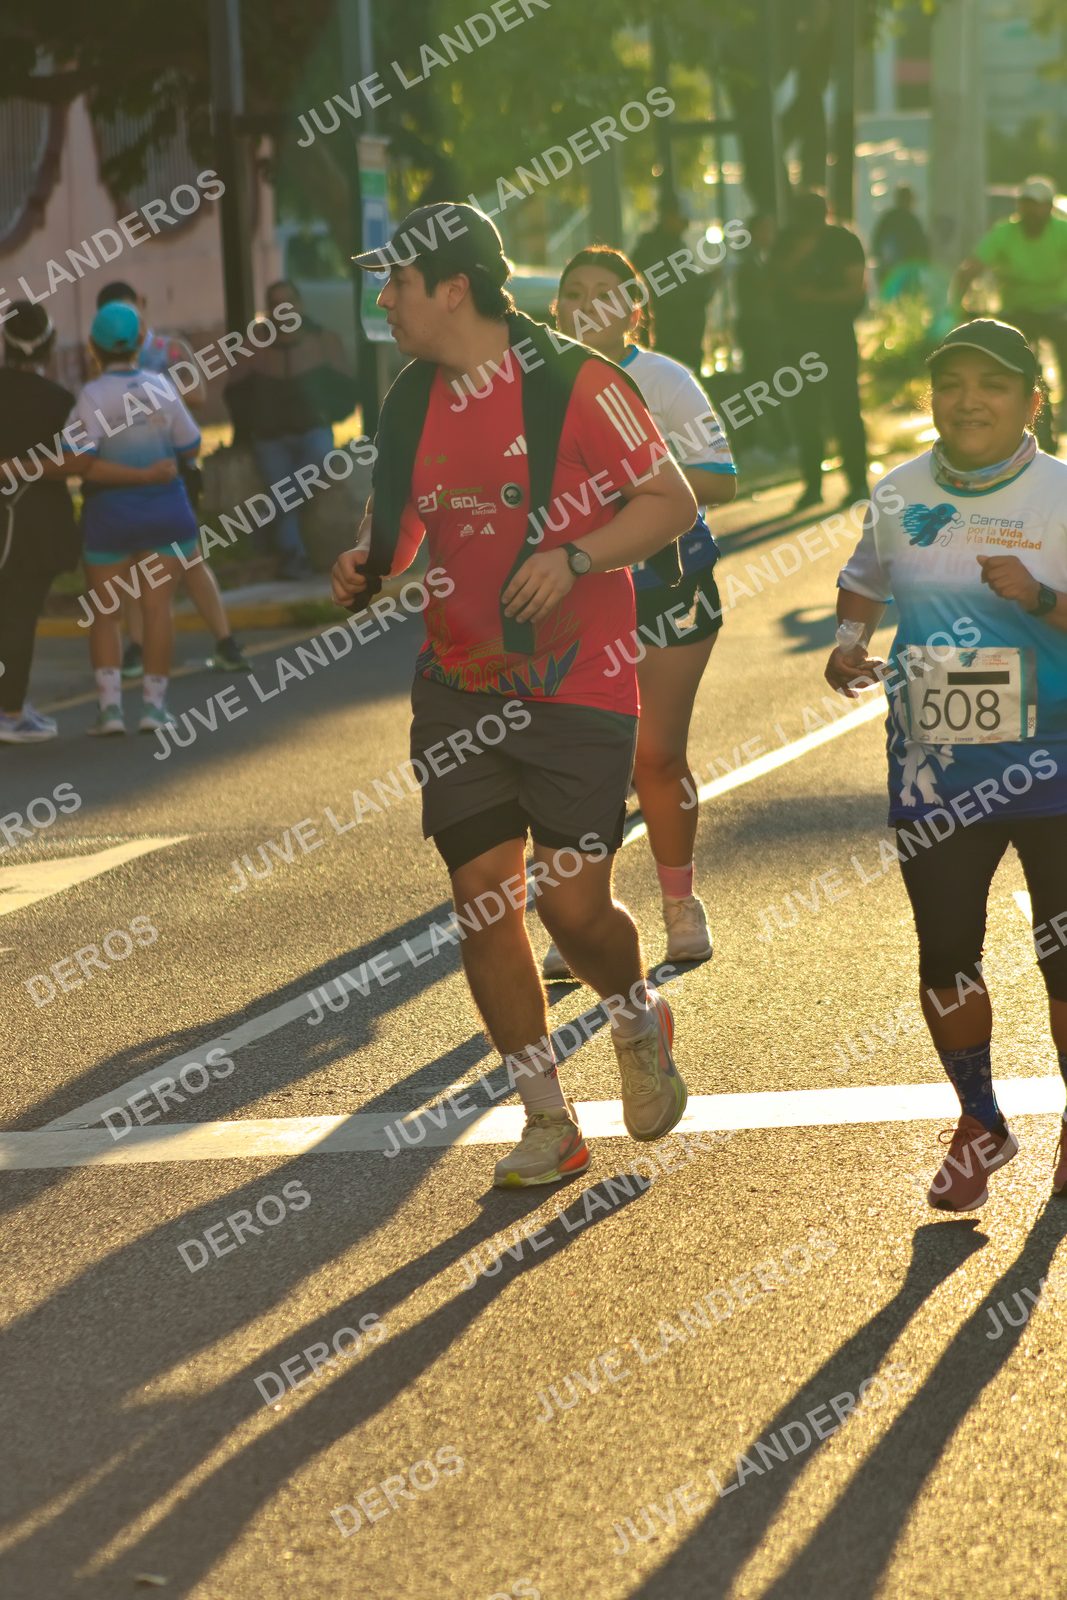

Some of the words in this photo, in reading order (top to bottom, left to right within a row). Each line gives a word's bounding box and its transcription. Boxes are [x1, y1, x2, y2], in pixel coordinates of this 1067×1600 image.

[451, 495, 493, 510] GDL
[970, 514, 1024, 529] Carrera
[968, 527, 986, 536] por
[987, 527, 996, 536] la
[999, 528, 1023, 538] Vida
[966, 536, 971, 544] y
[974, 535, 983, 544] la
[986, 535, 1042, 550] Integridad
[919, 688, 1000, 731] 508
